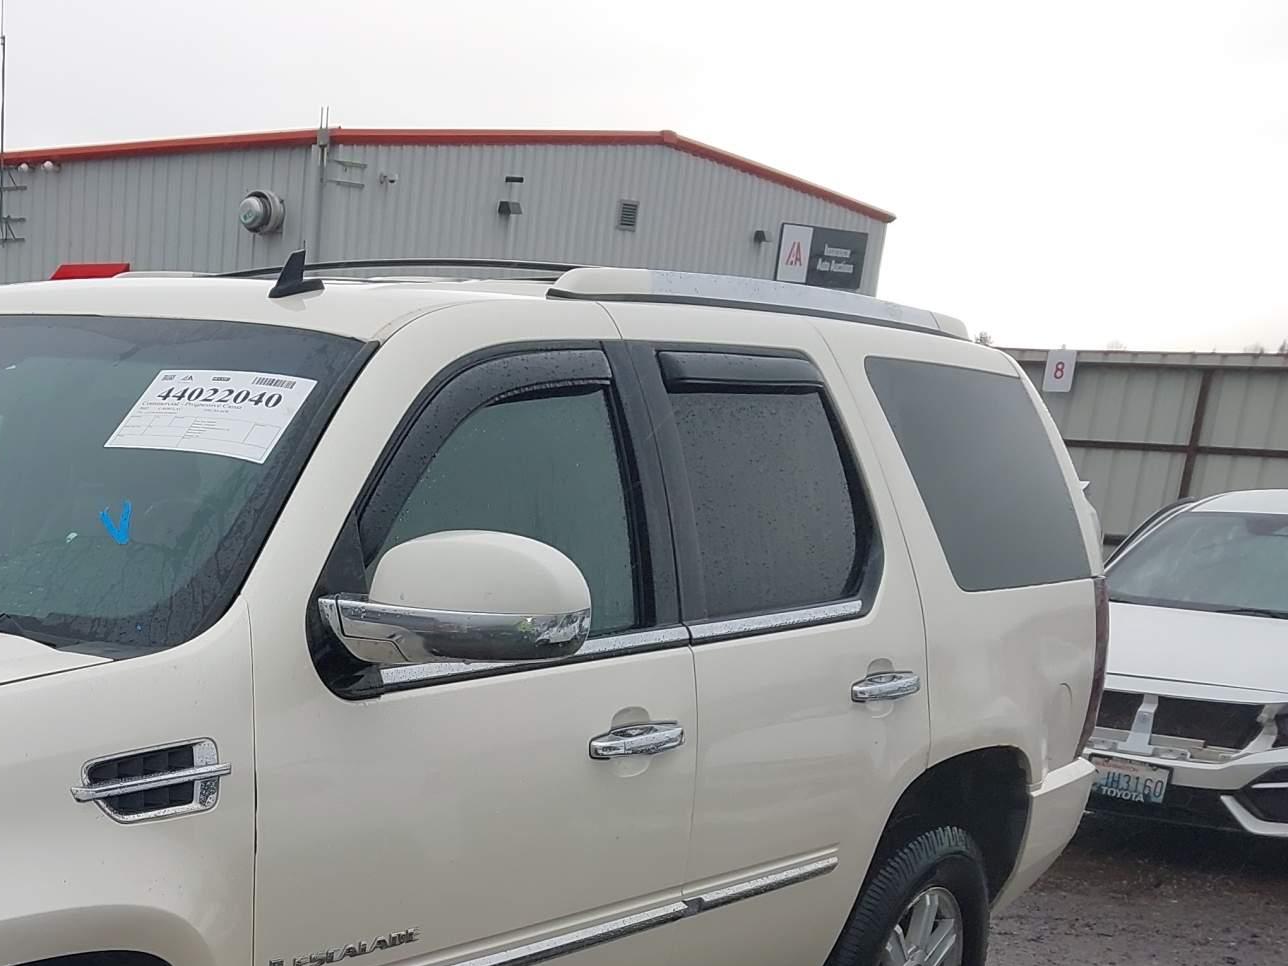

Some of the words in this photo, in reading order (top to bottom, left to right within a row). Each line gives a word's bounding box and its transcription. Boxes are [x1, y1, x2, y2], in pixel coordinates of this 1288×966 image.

[1054, 361, 1065, 380] 8
[156, 386, 283, 408] 44022040
[1101, 786, 1145, 802] TOYOTA
